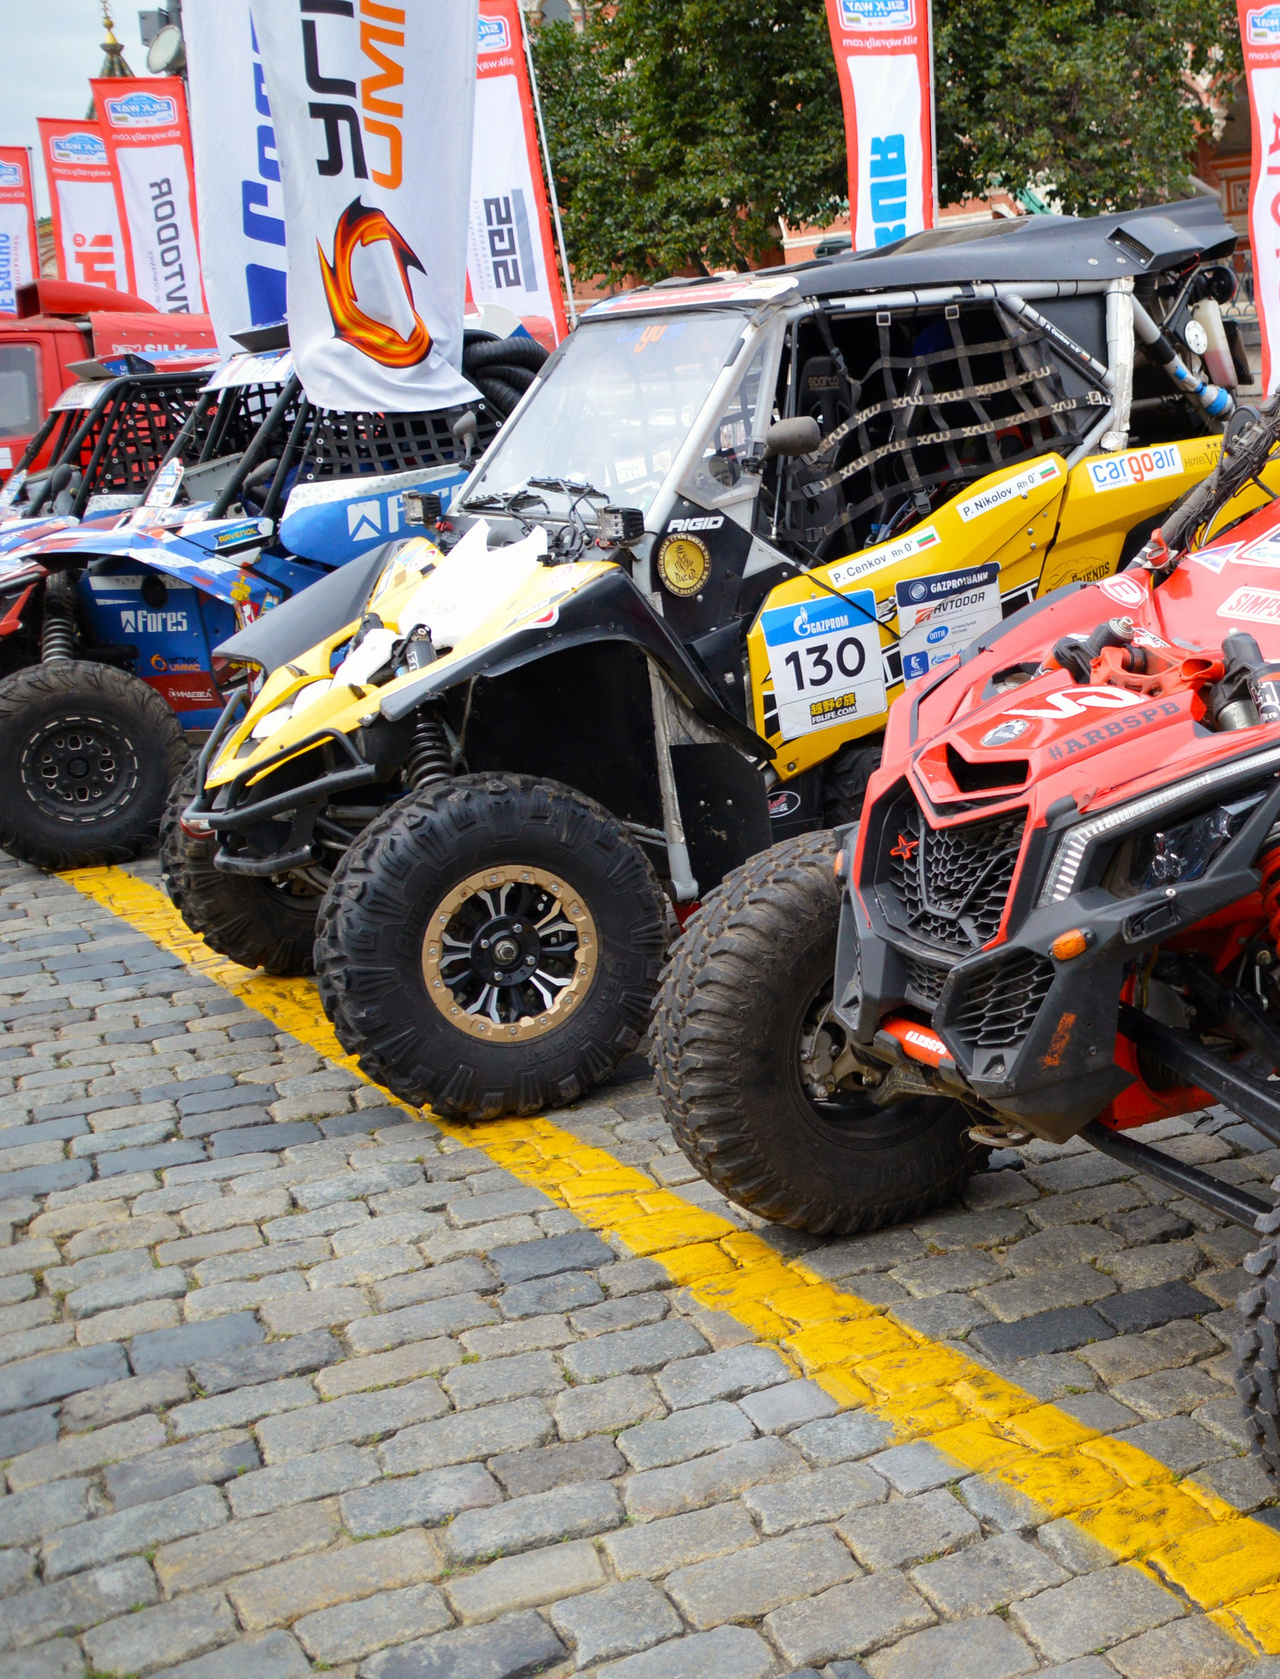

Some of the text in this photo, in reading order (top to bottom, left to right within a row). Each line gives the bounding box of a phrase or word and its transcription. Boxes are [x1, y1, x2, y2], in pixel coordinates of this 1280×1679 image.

[1092, 447, 1177, 484] cargoair
[962, 504, 975, 517] P.
[975, 487, 1013, 510] Nikolov
[1017, 479, 1029, 491] Rh
[218, 526, 258, 545] RAVENOL
[667, 516, 725, 533] RIGID
[832, 569, 846, 583] P.
[846, 554, 887, 577] Cenkov
[891, 546, 904, 559] Rh
[934, 591, 986, 615] AVTODOR
[810, 614, 849, 634] GAZPROM
[929, 629, 946, 641] ОПТИ
[169, 664, 201, 672] UMMC
[785, 636, 866, 691] 130
[810, 692, 857, 717] 越野e族
[811, 705, 857, 725] FBLIFE.COM
[1047, 701, 1181, 761] #ARBSPB
